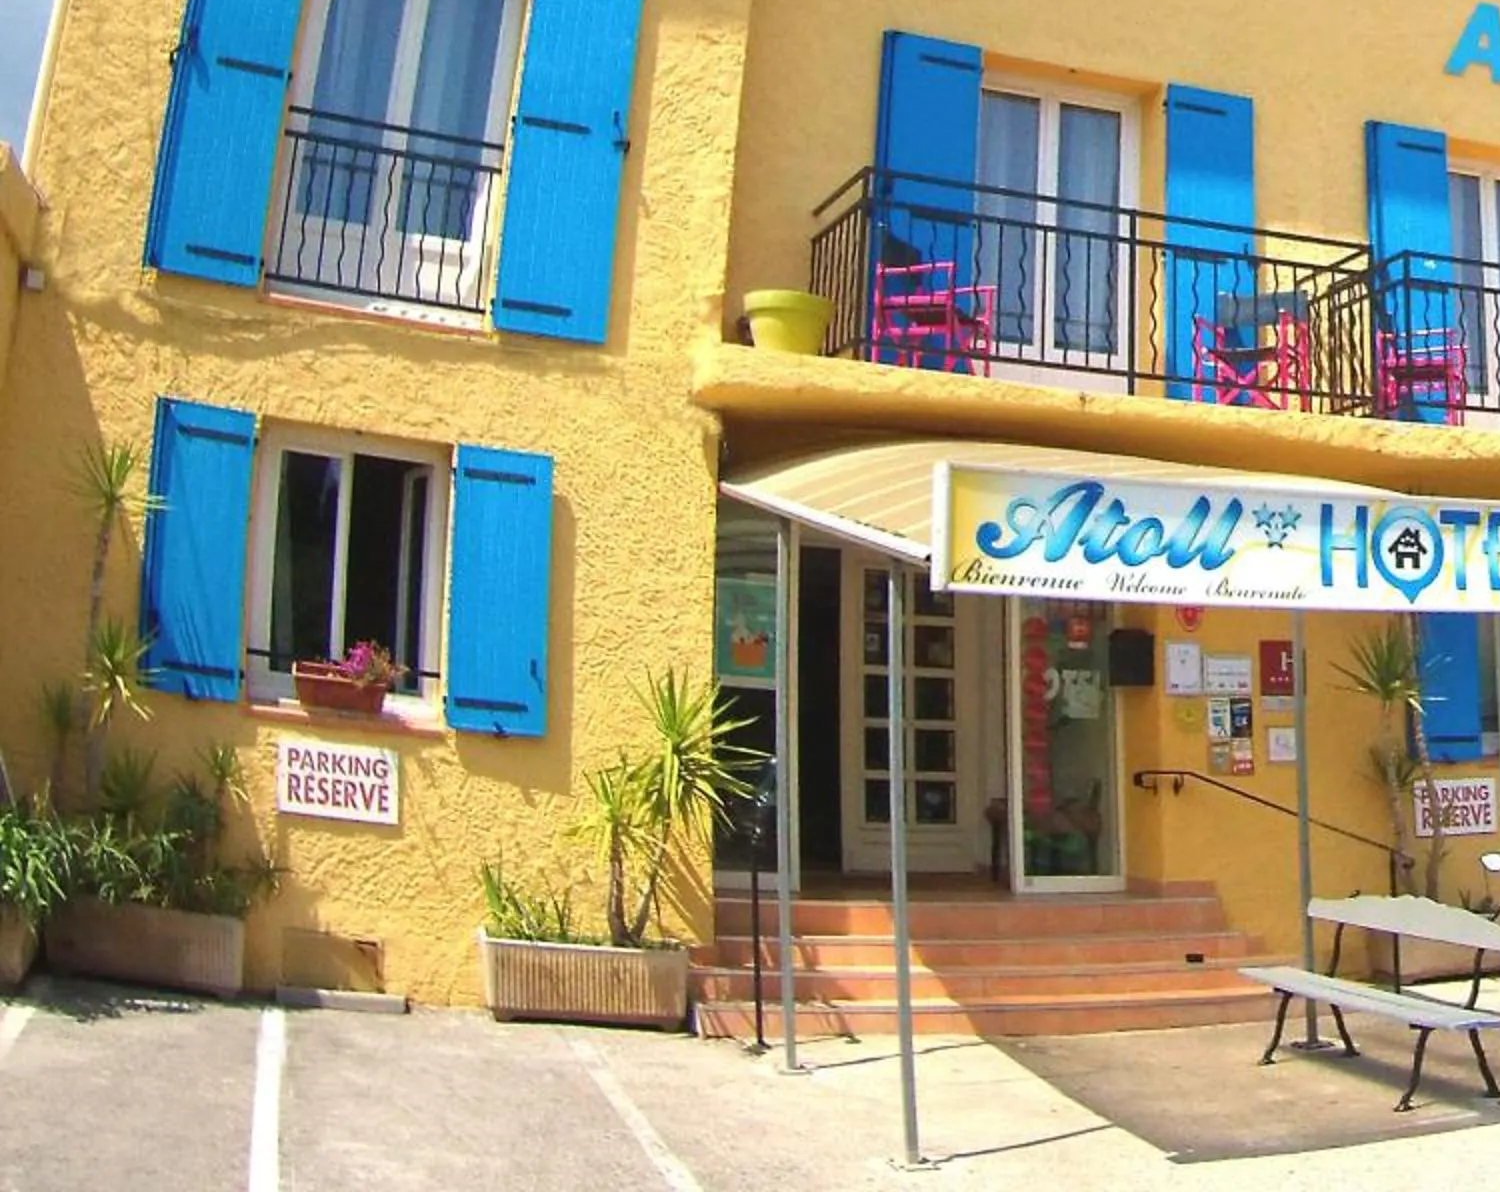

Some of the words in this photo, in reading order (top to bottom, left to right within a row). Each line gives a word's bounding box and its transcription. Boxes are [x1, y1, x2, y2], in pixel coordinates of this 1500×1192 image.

[976, 480, 1244, 571] Atoll
[951, 558, 1084, 592] Bienvenue
[1106, 570, 1188, 596] Welcome
[287, 747, 389, 779] PARKING
